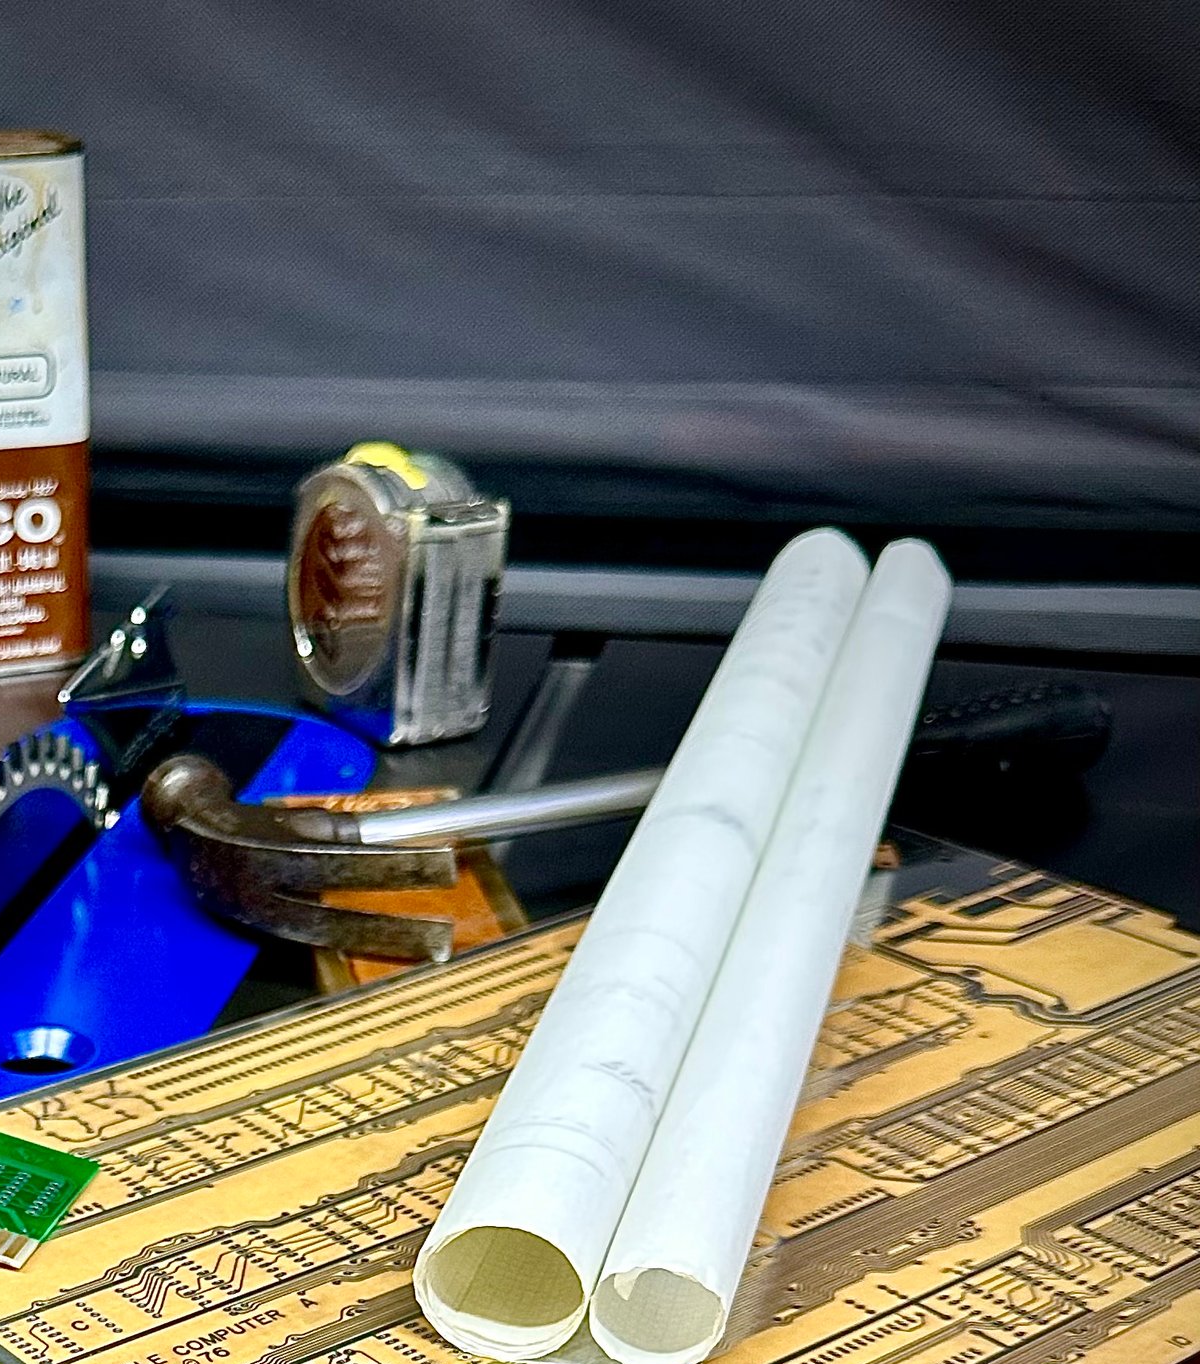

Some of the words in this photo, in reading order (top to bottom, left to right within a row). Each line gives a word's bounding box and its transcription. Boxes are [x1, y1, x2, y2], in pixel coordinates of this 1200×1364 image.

[71, 1320, 90, 1332] C
[172, 1309, 286, 1357] COMPUTER
[1166, 1335, 1192, 1349] 10
